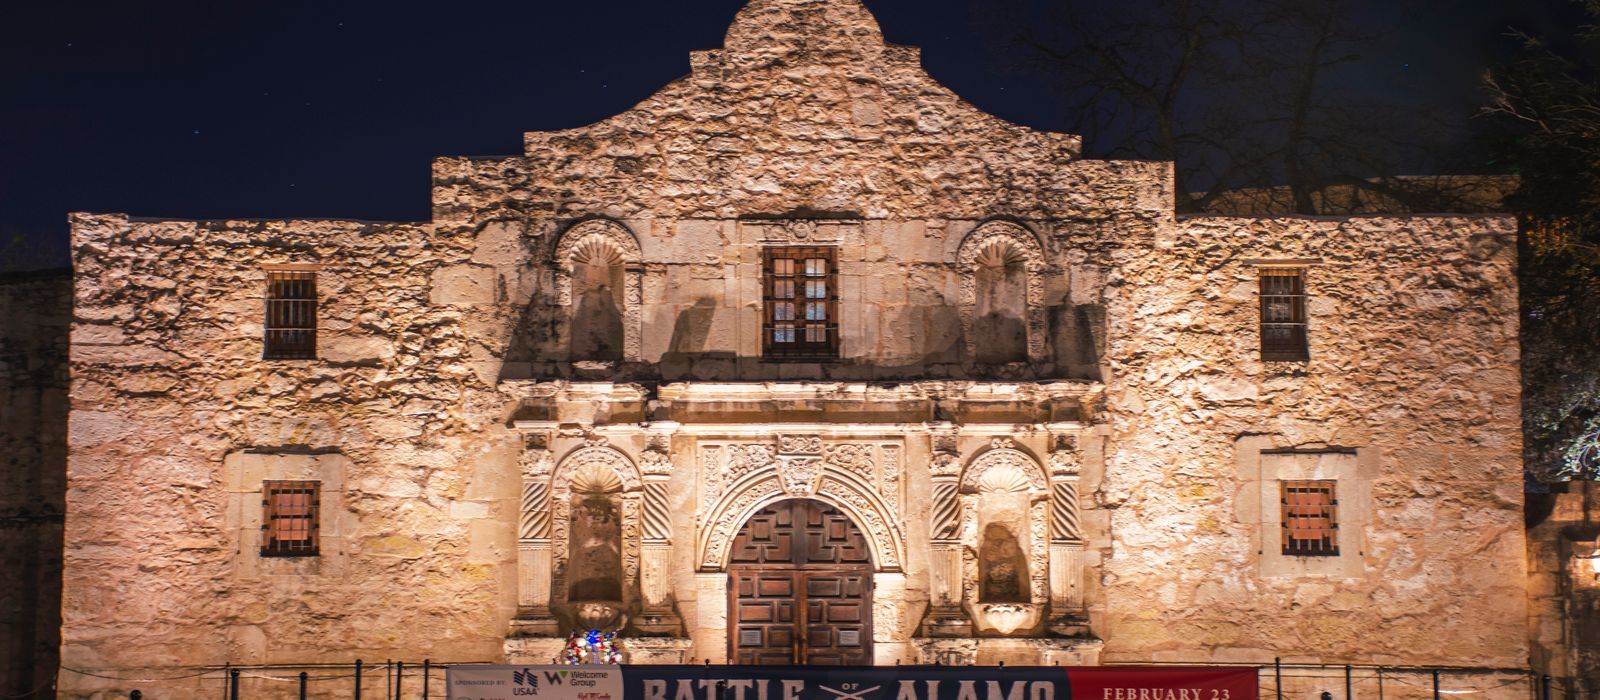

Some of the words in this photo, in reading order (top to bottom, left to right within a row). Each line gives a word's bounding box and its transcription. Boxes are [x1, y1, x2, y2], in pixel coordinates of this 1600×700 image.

[571, 671, 608, 679] Welcome
[571, 679, 597, 687] Group
[512, 688, 538, 696] USAA
[642, 679, 805, 700] BATTLE
[842, 683, 859, 691] OF
[896, 680, 1054, 700] ALAMO
[1103, 688, 1202, 700] FEBRUARY
[1212, 689, 1230, 700] 23
